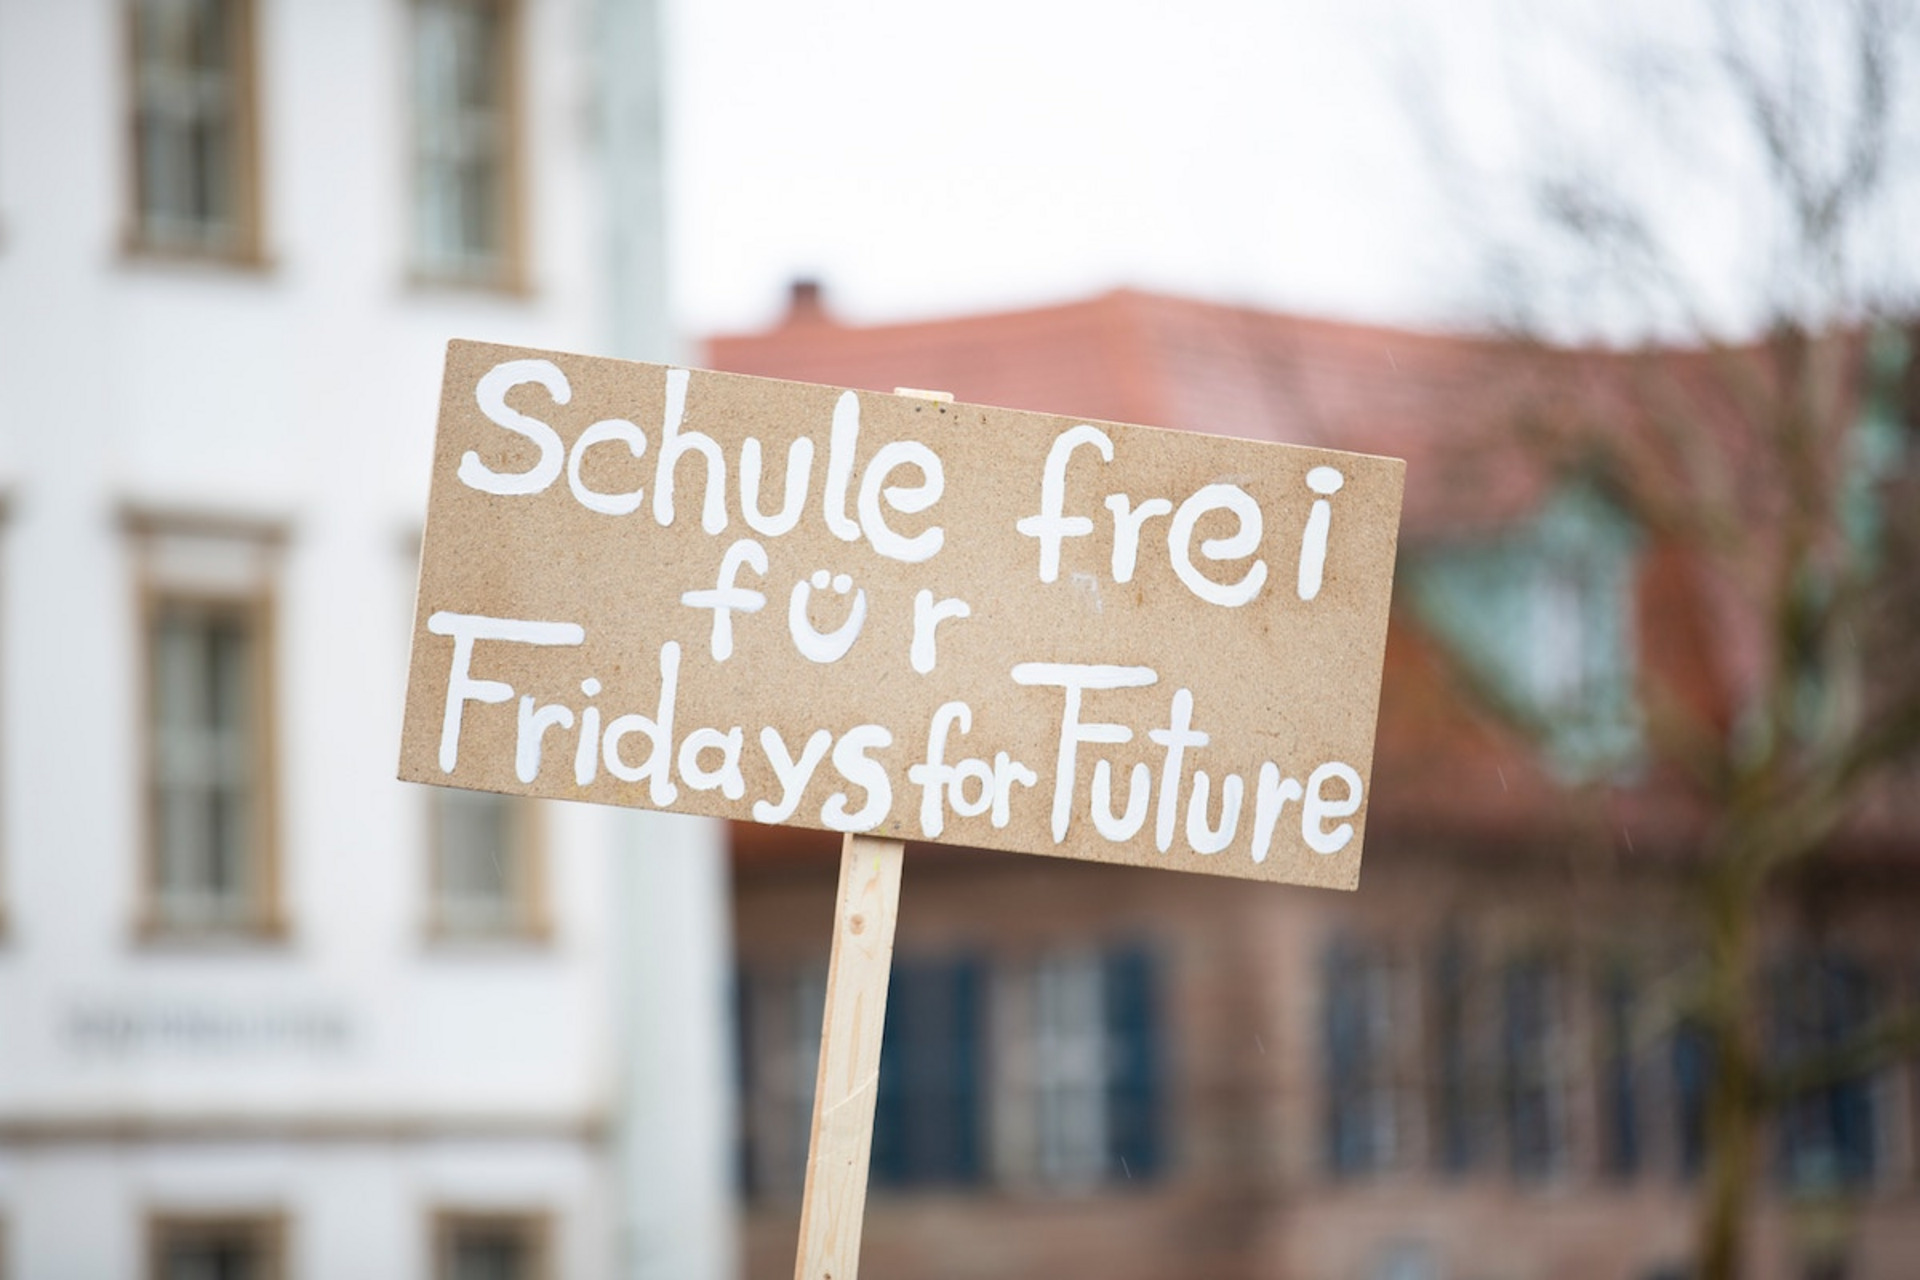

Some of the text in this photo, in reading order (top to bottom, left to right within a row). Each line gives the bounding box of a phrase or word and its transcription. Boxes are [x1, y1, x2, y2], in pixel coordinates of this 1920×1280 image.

[456, 358, 1345, 608] Schule frei
[681, 538, 970, 676] für
[427, 611, 1363, 864] Fridays for Future
